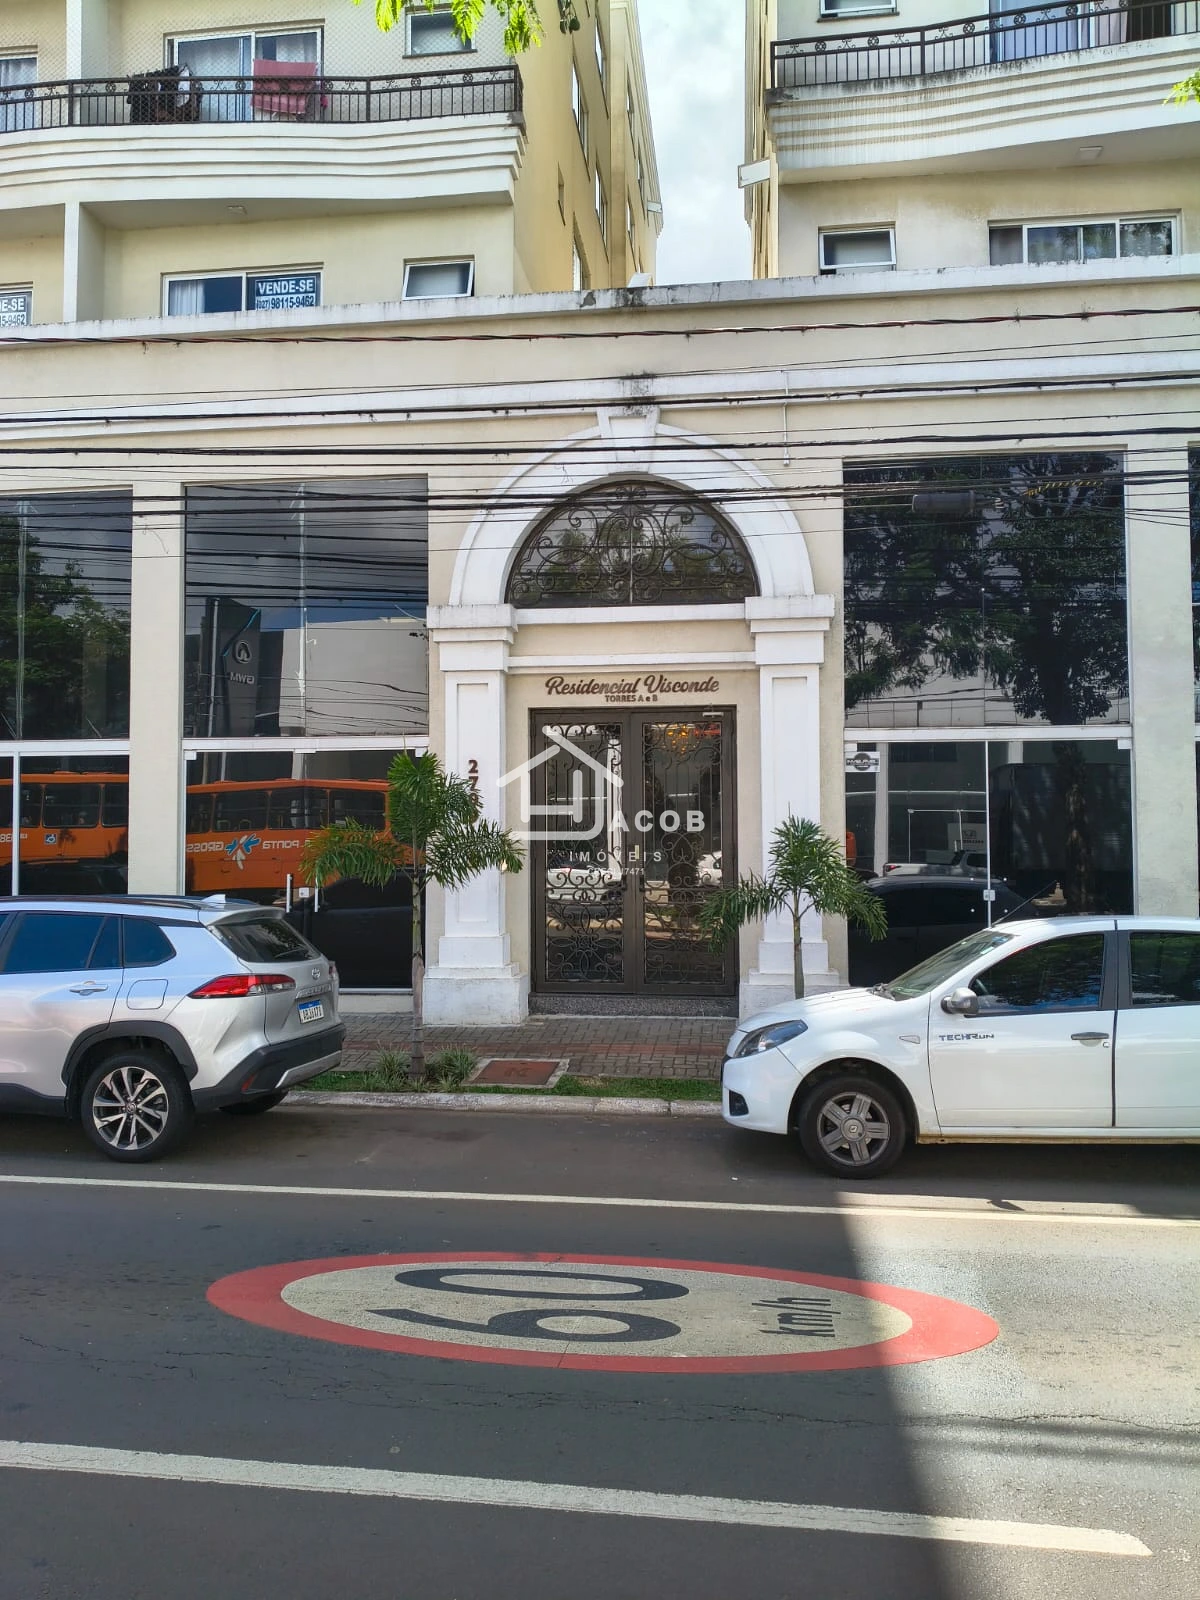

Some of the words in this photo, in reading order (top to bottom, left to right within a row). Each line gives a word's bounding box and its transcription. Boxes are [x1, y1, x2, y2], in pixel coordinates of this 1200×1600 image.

[258, 279, 314, 295] VENDE-SE
[545, 675, 642, 695] Residencial
[643, 674, 720, 694] Visconde
[605, 694, 637, 703] TORRES
[637, 694, 644, 703] A
